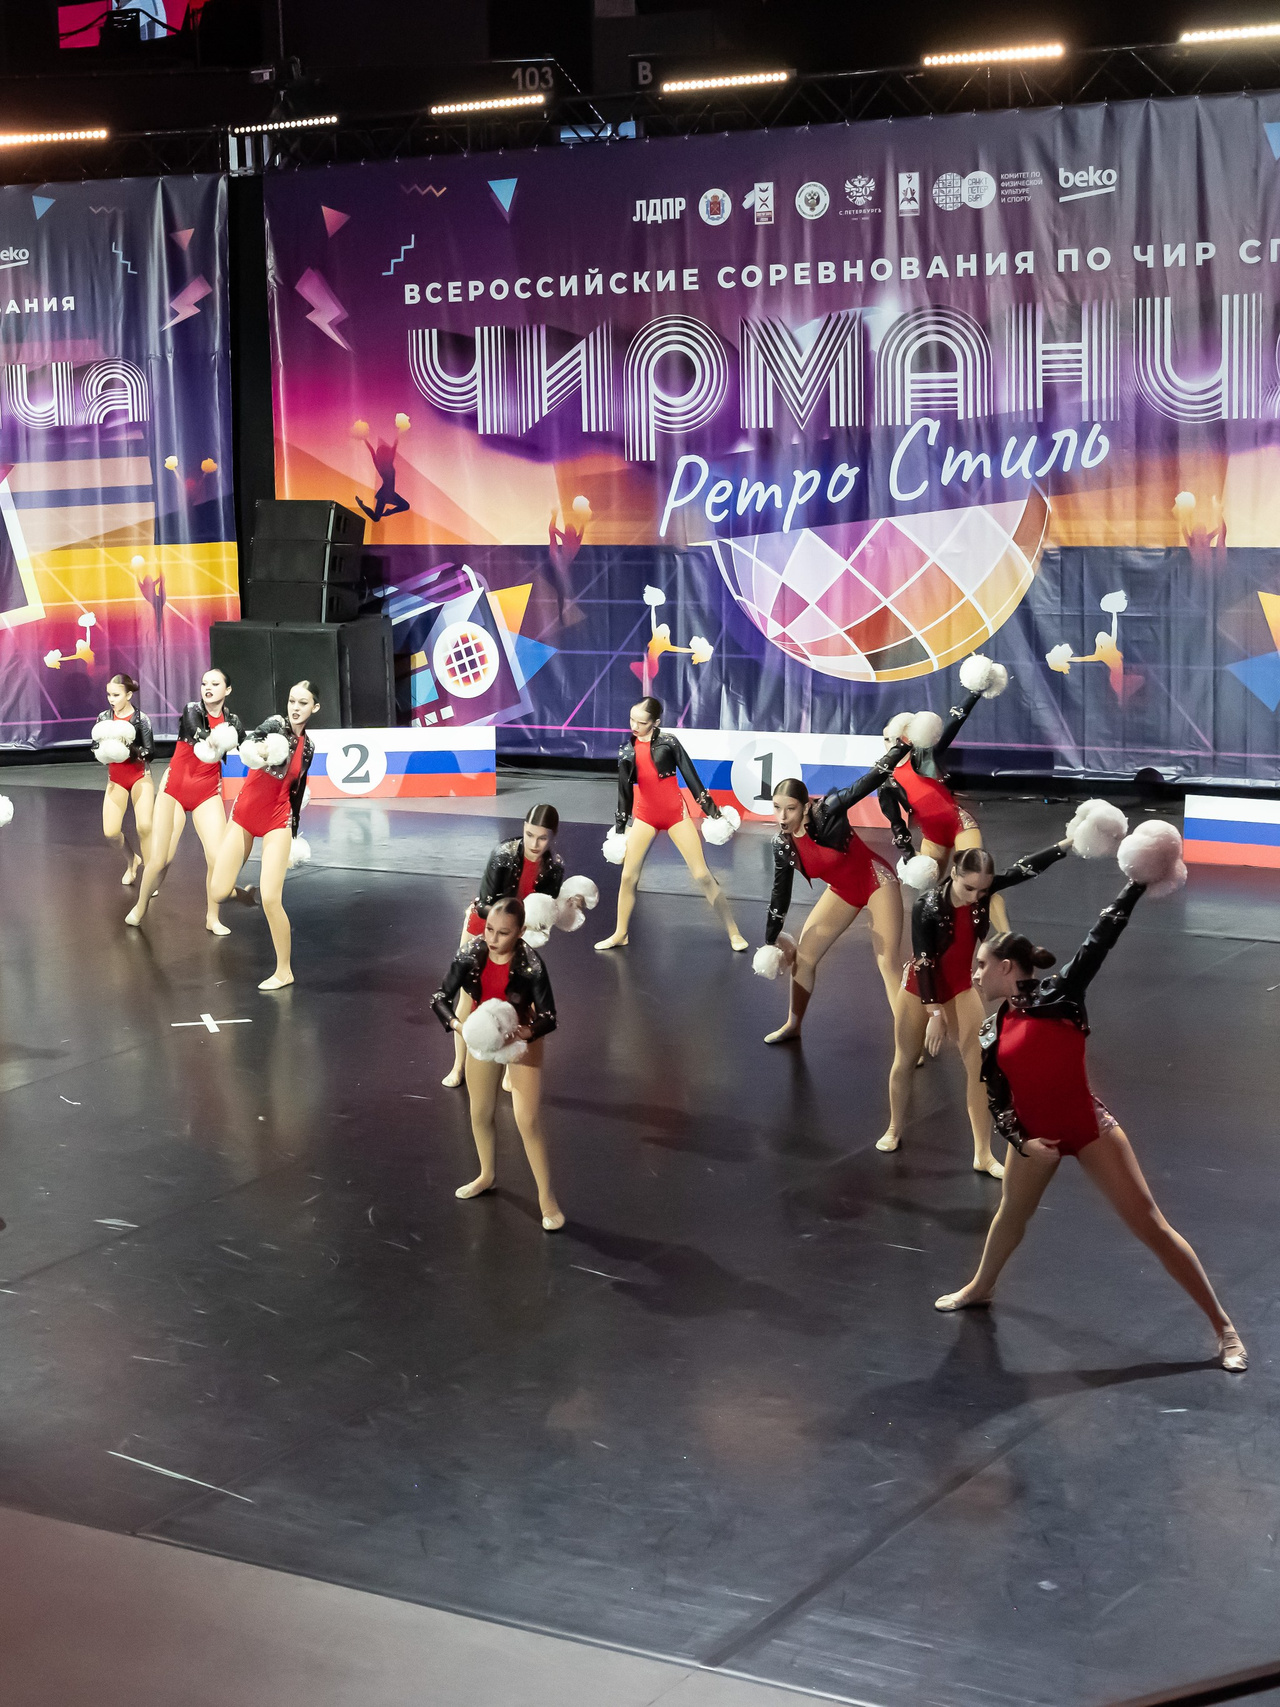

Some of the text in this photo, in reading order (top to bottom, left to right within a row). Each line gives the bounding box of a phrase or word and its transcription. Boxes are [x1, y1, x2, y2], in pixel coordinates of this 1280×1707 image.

[512, 66, 554, 91] 103
[637, 61, 653, 85] B
[1058, 166, 1117, 188] beko
[632, 197, 687, 224] ЛДПР
[404, 268, 699, 305] ВСЕРОССИЙСКИЕ
[717, 250, 1034, 289] СОРЕВНОВАНИЯ
[1057, 247, 1111, 273] ПО
[1133, 241, 1217, 269] ЧИР
[659, 417, 1111, 537] Ретро Стиль
[341, 743, 371, 784] 2
[753, 752, 774, 800] 1
